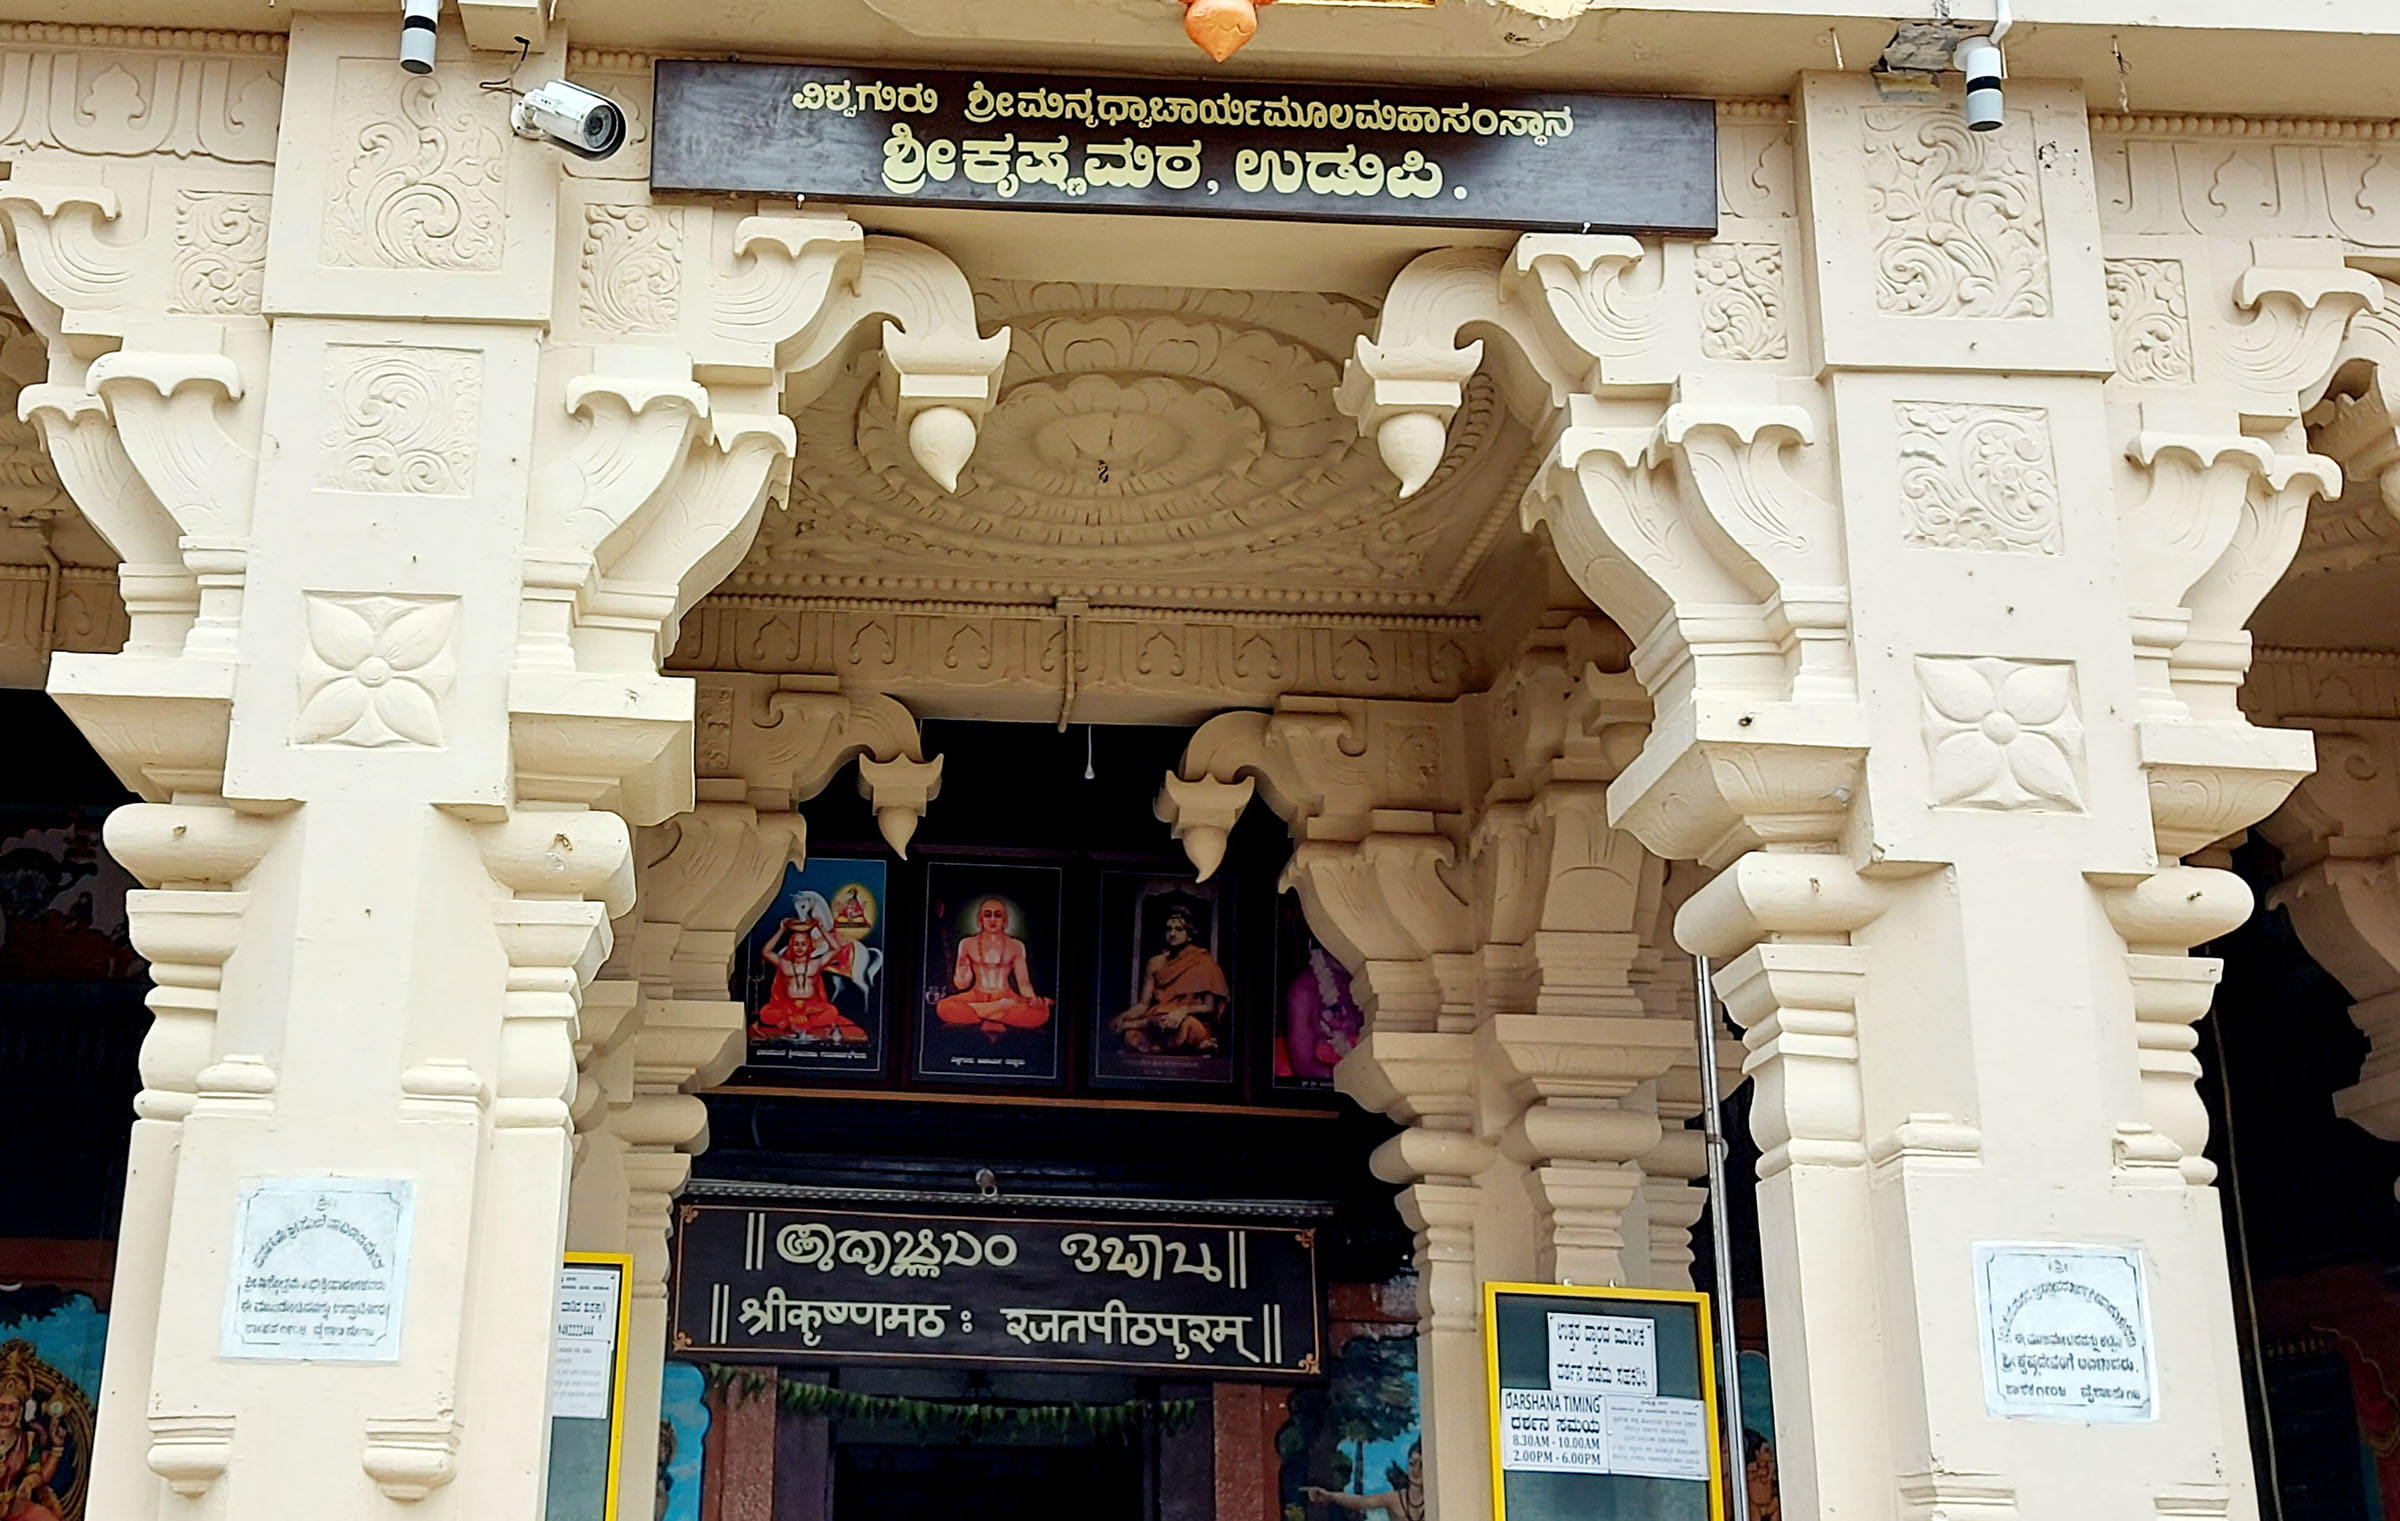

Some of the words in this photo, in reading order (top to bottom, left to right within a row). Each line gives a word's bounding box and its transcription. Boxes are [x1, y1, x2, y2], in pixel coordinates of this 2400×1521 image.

[792, 80, 938, 117] ವಿಶ್ವಗುರು
[1235, 143, 1468, 199] ಉಡುಪಿ.
[999, 1299, 1260, 1363] रजतपीठपुरम्
[1505, 1392, 1561, 1411] DARSHANA
[1563, 1395, 1600, 1413] TIMING
